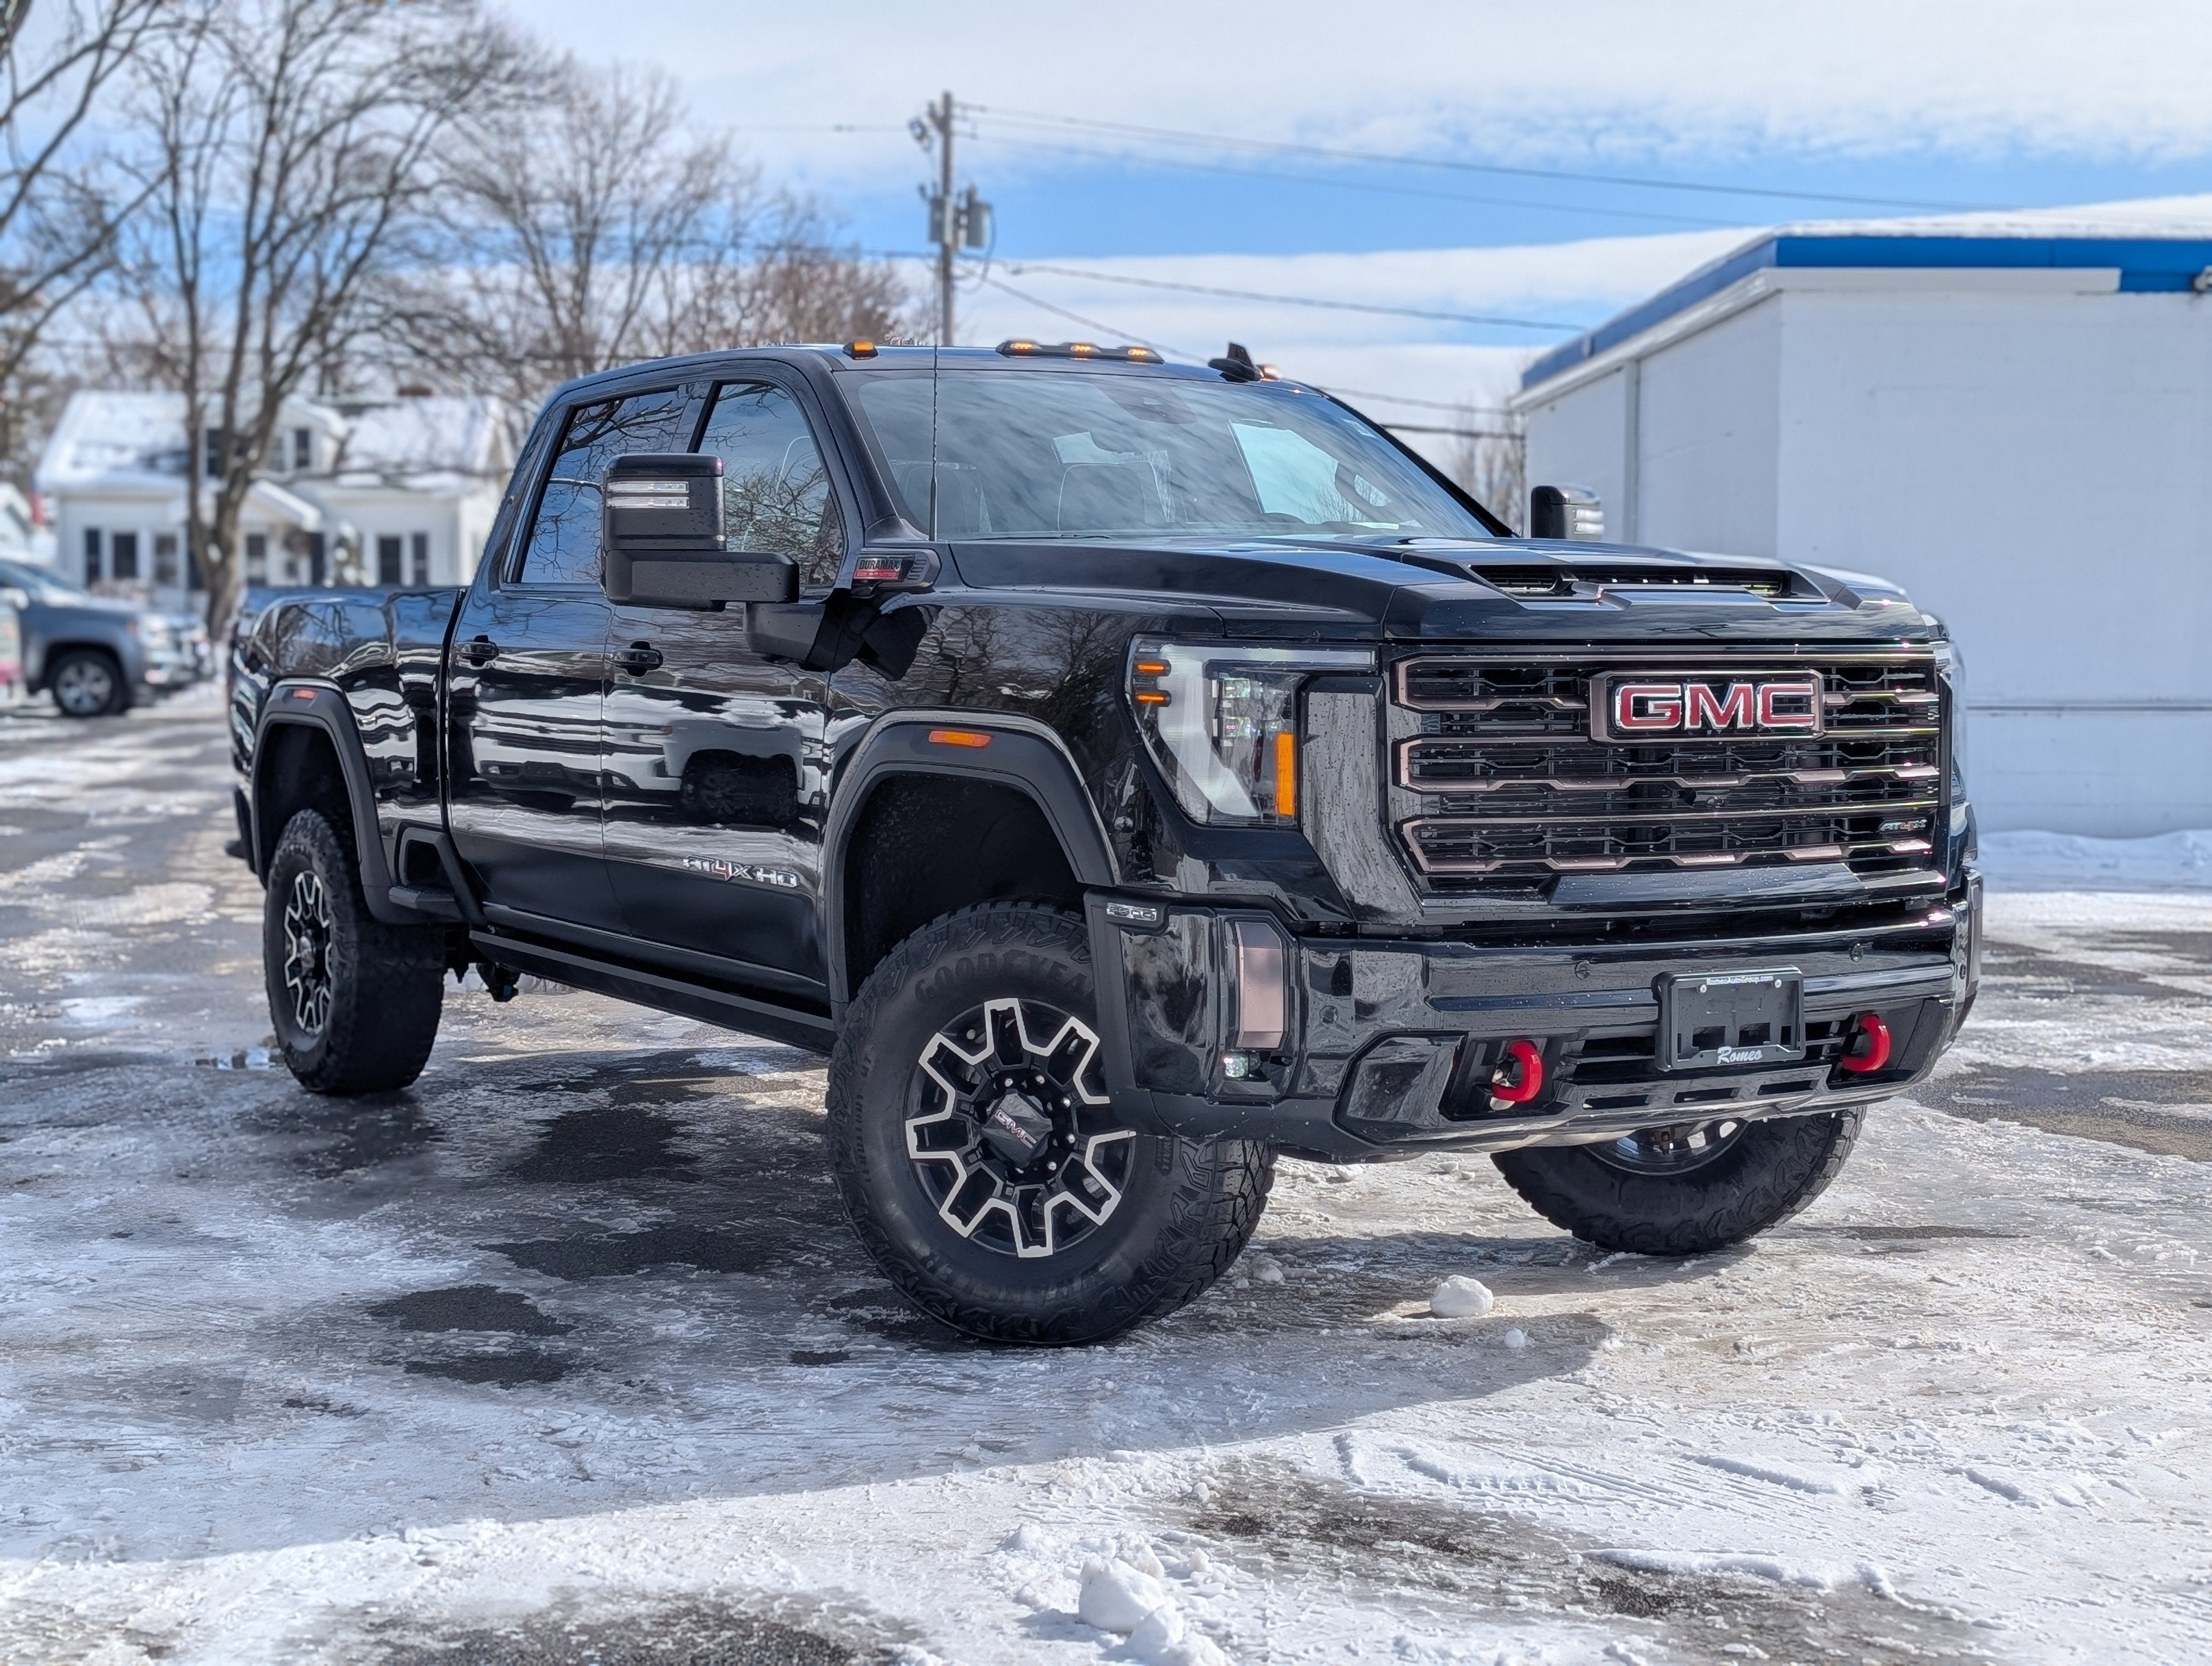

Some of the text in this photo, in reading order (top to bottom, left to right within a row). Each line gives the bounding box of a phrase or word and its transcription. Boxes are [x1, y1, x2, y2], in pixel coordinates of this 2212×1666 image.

[859, 559, 901, 571] DURAMAX
[1615, 683, 1815, 731] GMC
[683, 855, 800, 888] AT4X HD
[915, 949, 1095, 1003] GOODYEA
[1716, 1046, 1763, 1065] Romeo
[994, 1108, 1037, 1149] GMC
